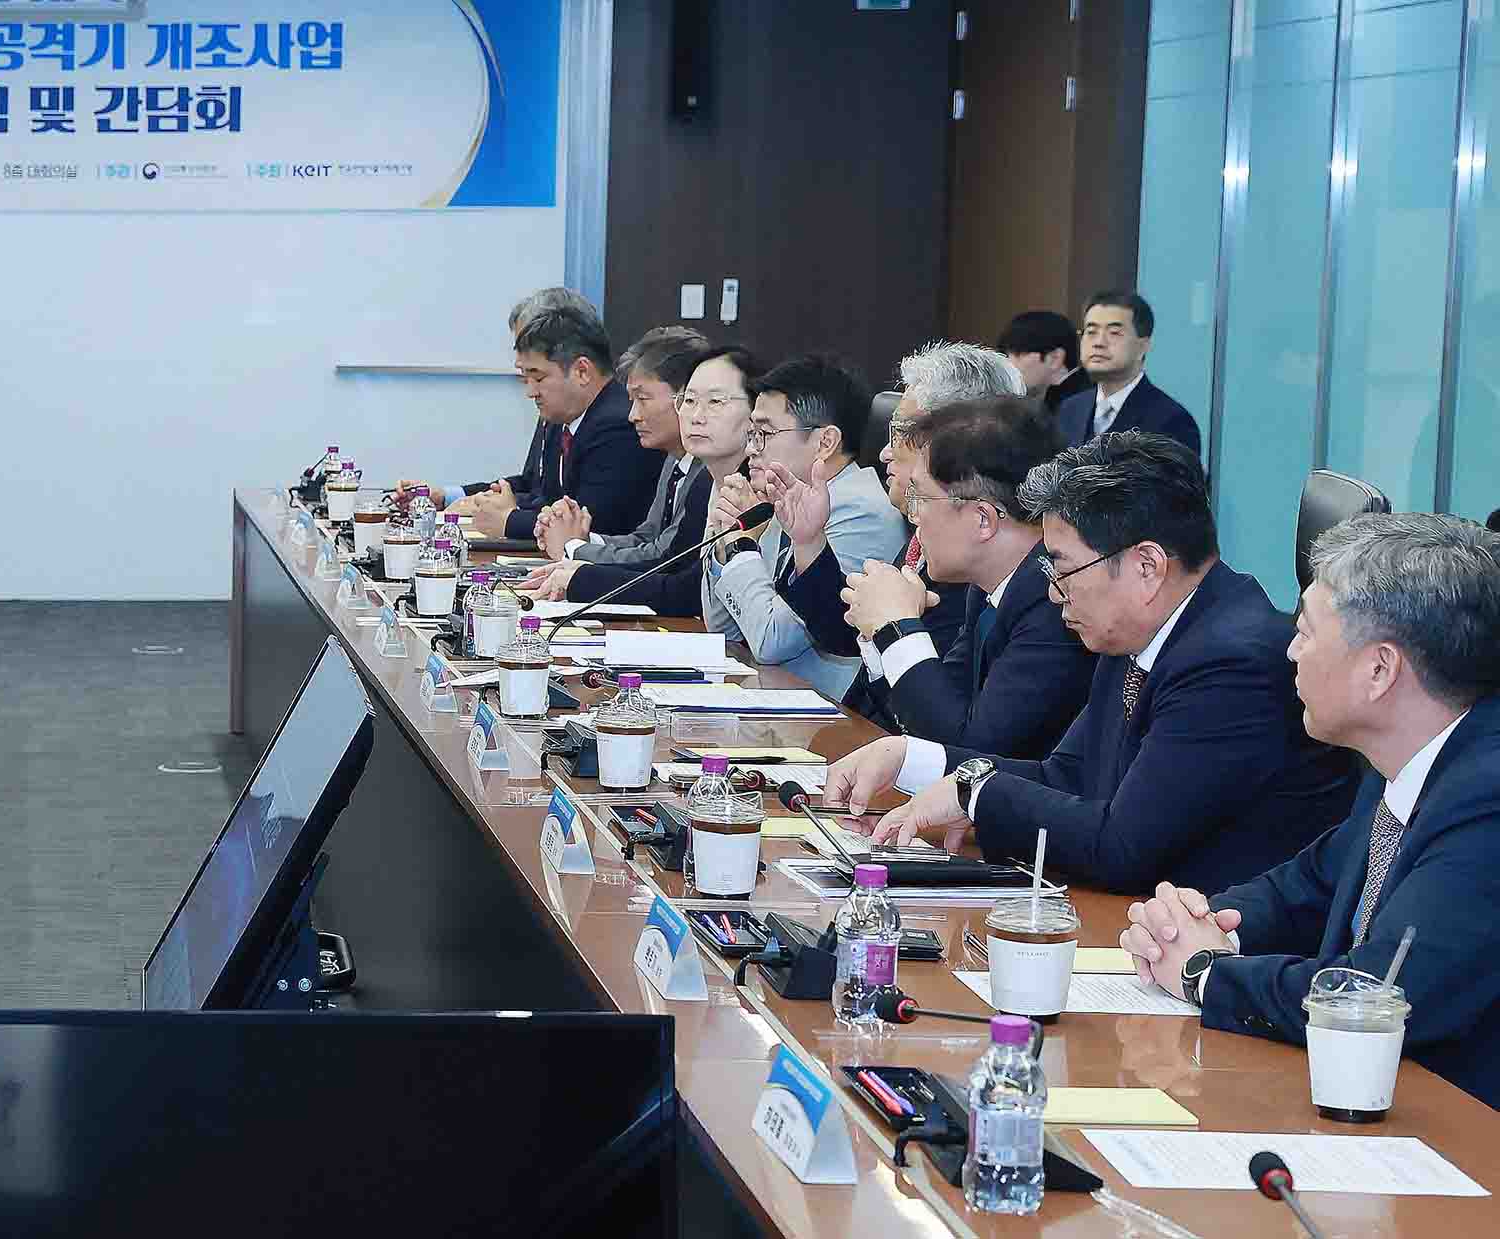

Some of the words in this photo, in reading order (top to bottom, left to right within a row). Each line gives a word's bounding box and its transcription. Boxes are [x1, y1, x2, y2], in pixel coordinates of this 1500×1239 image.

[144, 21, 343, 70] 개조사업
[29, 85, 76, 133] 및
[93, 85, 242, 133] 간담회
